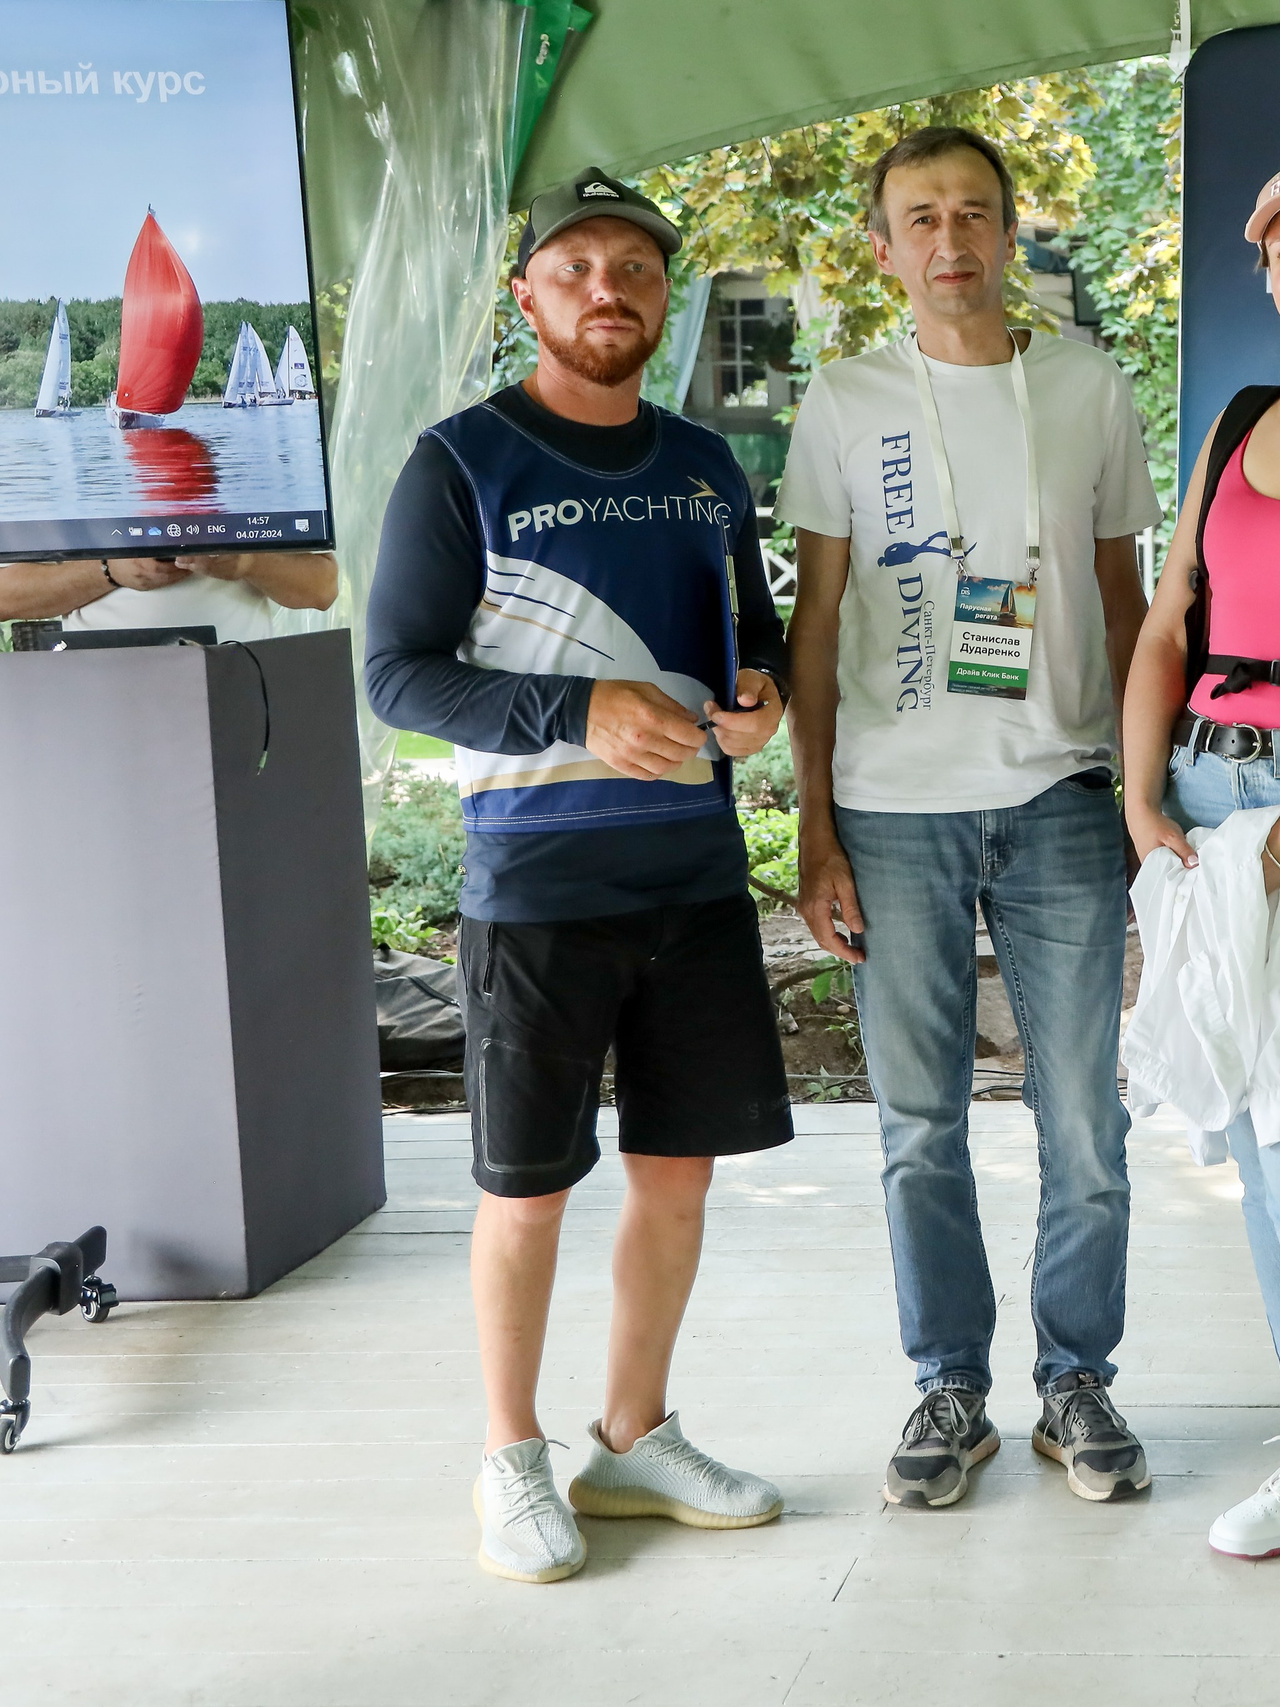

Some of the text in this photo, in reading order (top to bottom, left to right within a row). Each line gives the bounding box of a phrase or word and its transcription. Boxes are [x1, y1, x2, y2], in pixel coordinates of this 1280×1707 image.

[113, 71, 206, 103] курс
[881, 430, 916, 535] FREE
[247, 516, 270, 525] 14:57
[508, 495, 732, 543] PROYACHTING
[207, 525, 226, 534] ENG
[236, 529, 283, 539] 04.07.2024
[960, 603, 992, 612] Парусная
[896, 573, 924, 713] DIVING
[962, 631, 1020, 646] Станислав
[920, 600, 936, 710] Санкт-Петербург
[960, 643, 1021, 658] Дударенко
[956, 668, 980, 676] Драйв
[982, 670, 1000, 678] Клик
